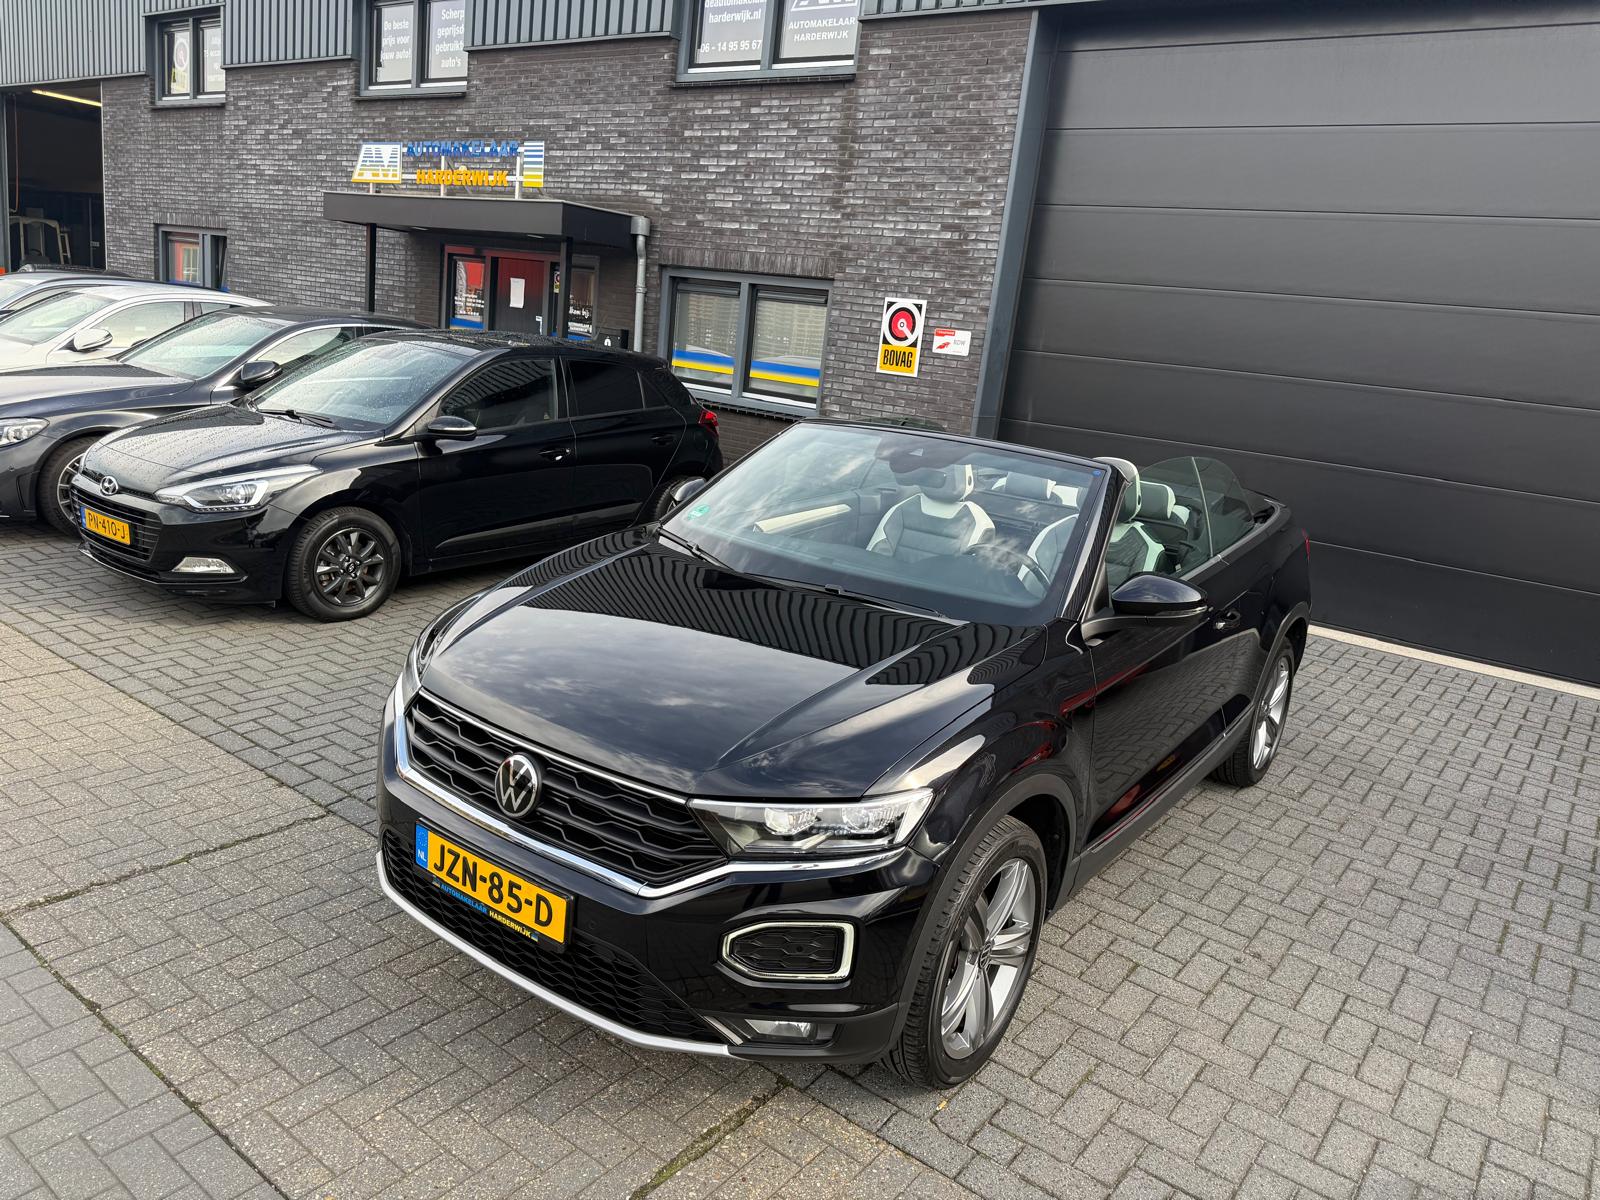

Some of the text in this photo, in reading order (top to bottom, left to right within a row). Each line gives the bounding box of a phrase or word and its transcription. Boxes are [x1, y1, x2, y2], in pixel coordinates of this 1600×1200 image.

[709, 8, 762, 24] harderwijk.nl
[788, 16, 856, 30] AUTOMAKELAAR
[393, 19, 409, 30] beste
[437, 24, 464, 39] geprijsd
[382, 35, 410, 48] prijs voor
[794, 30, 849, 42] HARDERWIJK
[700, 43, 710, 53] 06
[718, 42, 727, 52] 14
[729, 41, 738, 51] 95
[740, 40, 750, 51] 95
[752, 39, 762, 50] 67
[396, 48, 411, 59] auto!
[441, 56, 461, 68] auto's
[406, 140, 520, 158] AUTOMAKELAAR
[416, 169, 508, 187] HARDERWIJK
[882, 349, 913, 368] BOVAG
[88, 511, 126, 539] PN-410-J
[417, 849, 427, 862] NL
[433, 844, 553, 928] JZN-85-D
[440, 884, 532, 939] AUTOMAKELAAR HARDERWIJK
